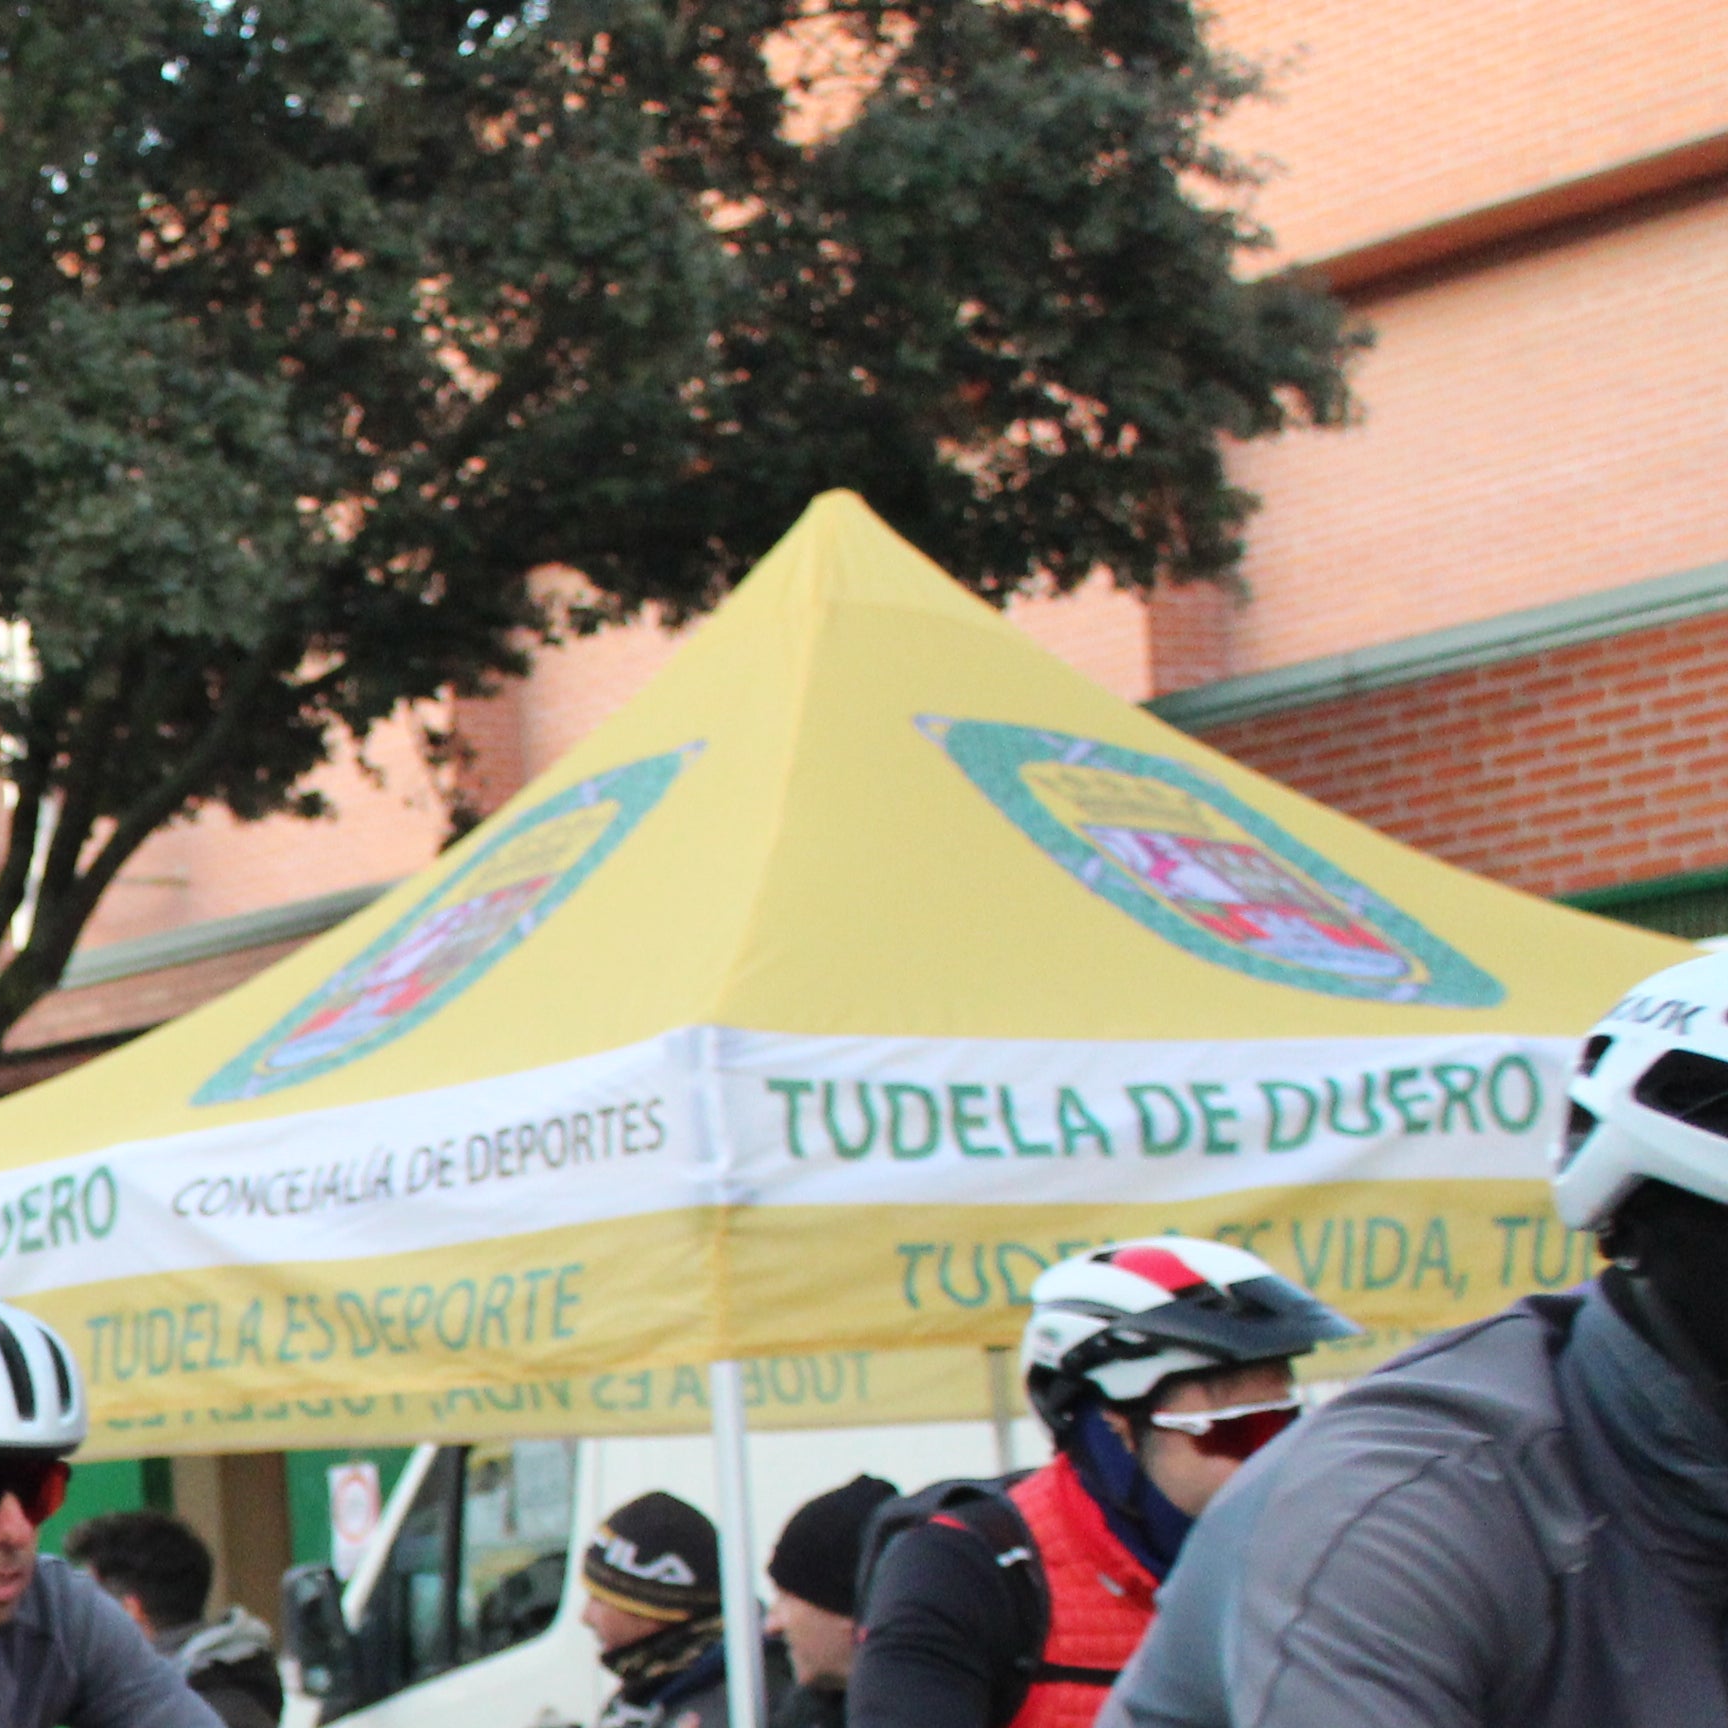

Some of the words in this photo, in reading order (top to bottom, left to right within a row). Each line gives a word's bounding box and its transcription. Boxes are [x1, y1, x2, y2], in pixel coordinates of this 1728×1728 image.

[406, 1141, 455, 1195] DE
[467, 1098, 667, 1186] DEPORTES
[768, 1079, 1112, 1160] TUDELA
[1126, 1082, 1240, 1156] DE
[1258, 1055, 1542, 1154] DUERO
[1291, 1217, 1470, 1298] VIDA,
[86, 1298, 265, 1385] TUDELA
[278, 1294, 337, 1363] ES
[338, 1263, 584, 1361] DEPORTE
